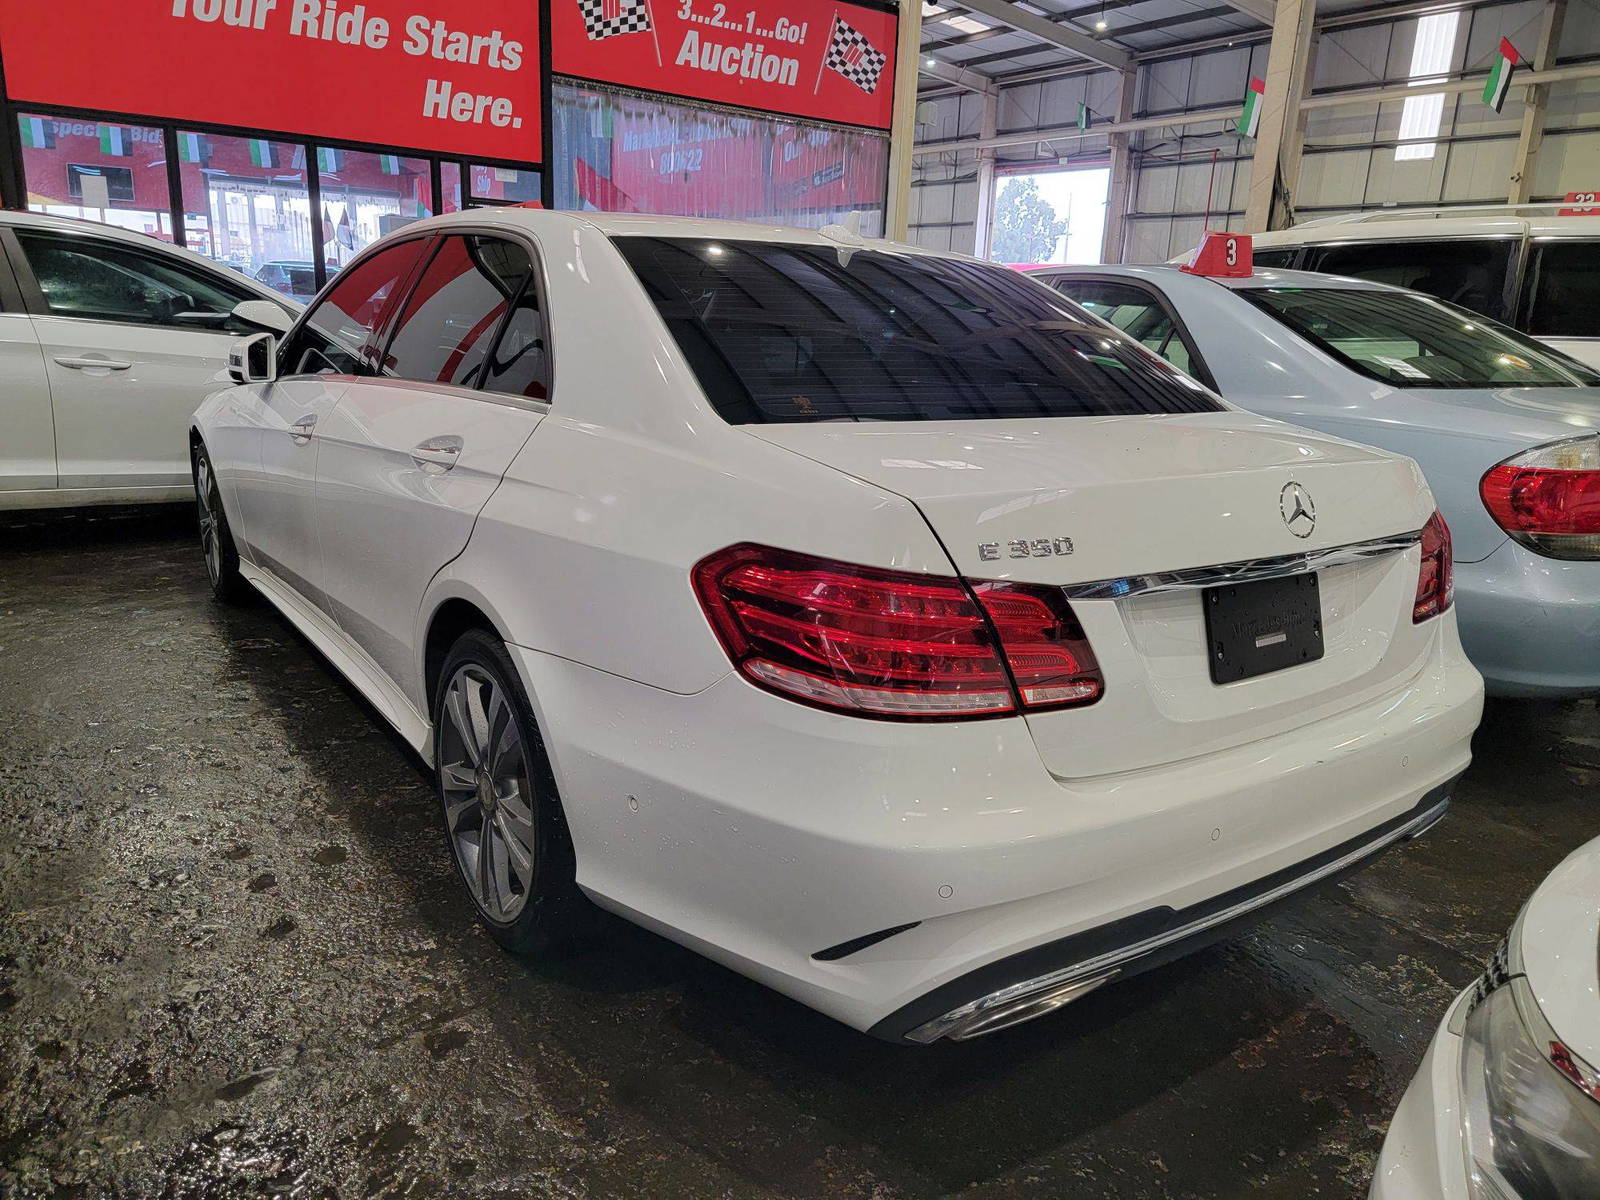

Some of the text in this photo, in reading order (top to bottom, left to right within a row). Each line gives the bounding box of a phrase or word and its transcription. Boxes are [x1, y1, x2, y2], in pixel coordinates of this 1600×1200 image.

[290, 0, 390, 49] Ride
[403, 15, 523, 71] Starts
[675, 29, 800, 86] Auction
[423, 79, 523, 128] Here.
[1226, 238, 1237, 266] 3
[978, 537, 1074, 561] E 350
